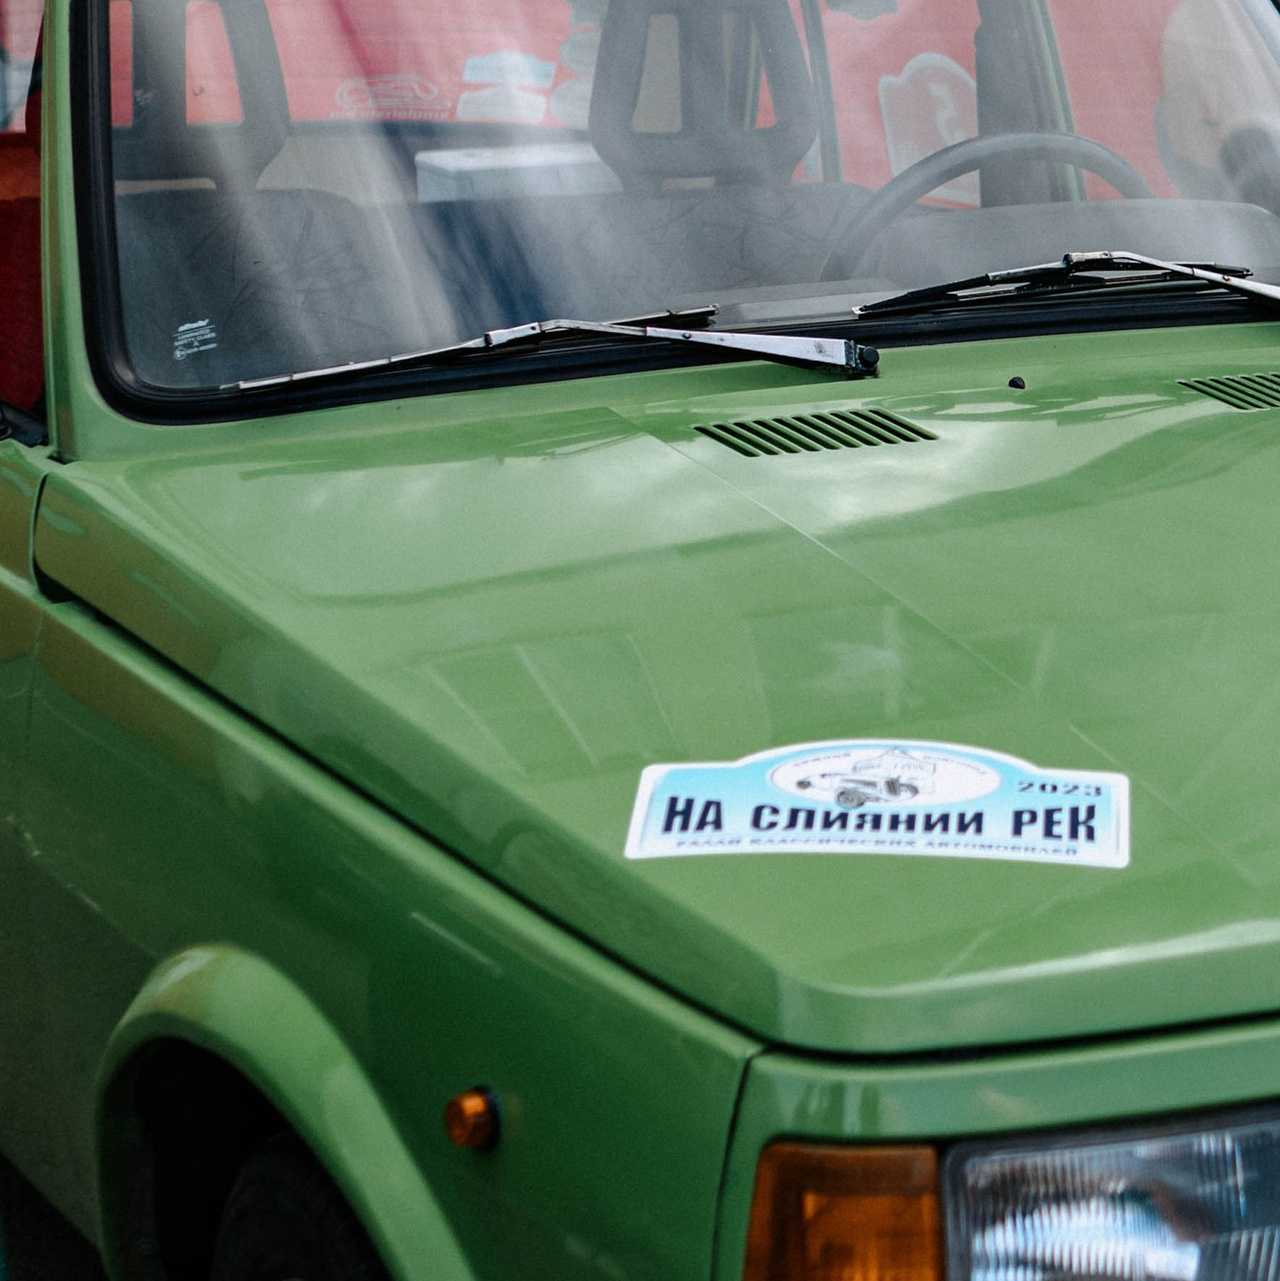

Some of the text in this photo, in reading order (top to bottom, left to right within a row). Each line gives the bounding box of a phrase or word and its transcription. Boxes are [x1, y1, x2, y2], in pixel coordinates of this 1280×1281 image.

[1016, 780, 1102, 797] 2023
[662, 795, 723, 834] НА
[1012, 804, 1097, 842] РЕК
